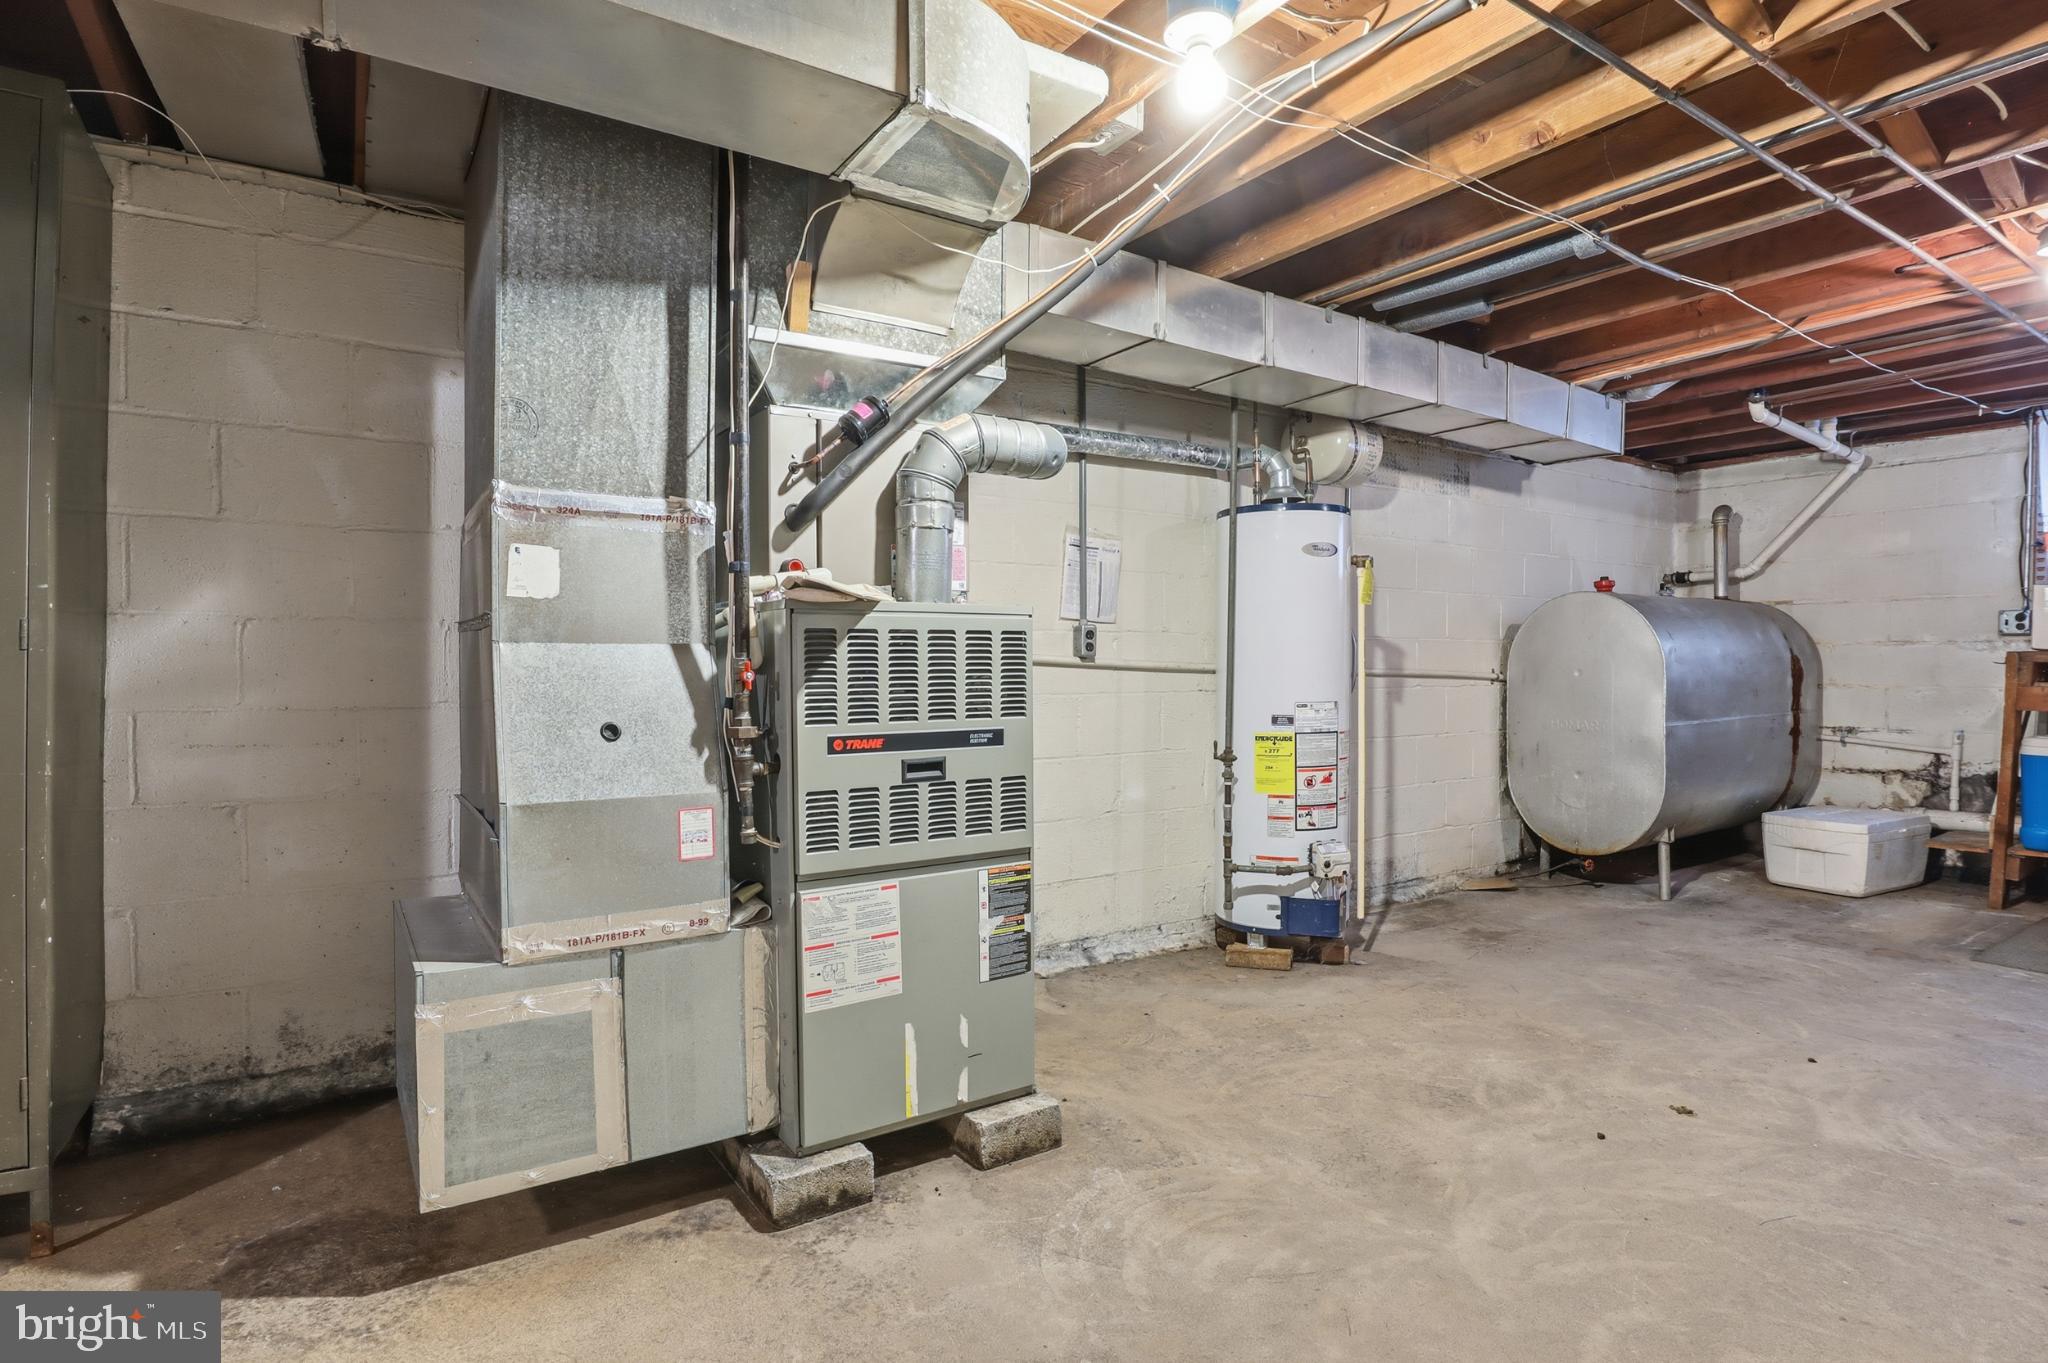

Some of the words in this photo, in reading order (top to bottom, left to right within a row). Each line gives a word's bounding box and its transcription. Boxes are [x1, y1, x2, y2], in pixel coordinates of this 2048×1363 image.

[556, 505, 581, 515] 324A
[846, 738, 885, 749] TRANE
[567, 928, 647, 947] 181A-P/181B-FX
[688, 917, 709, 928] 8-99
